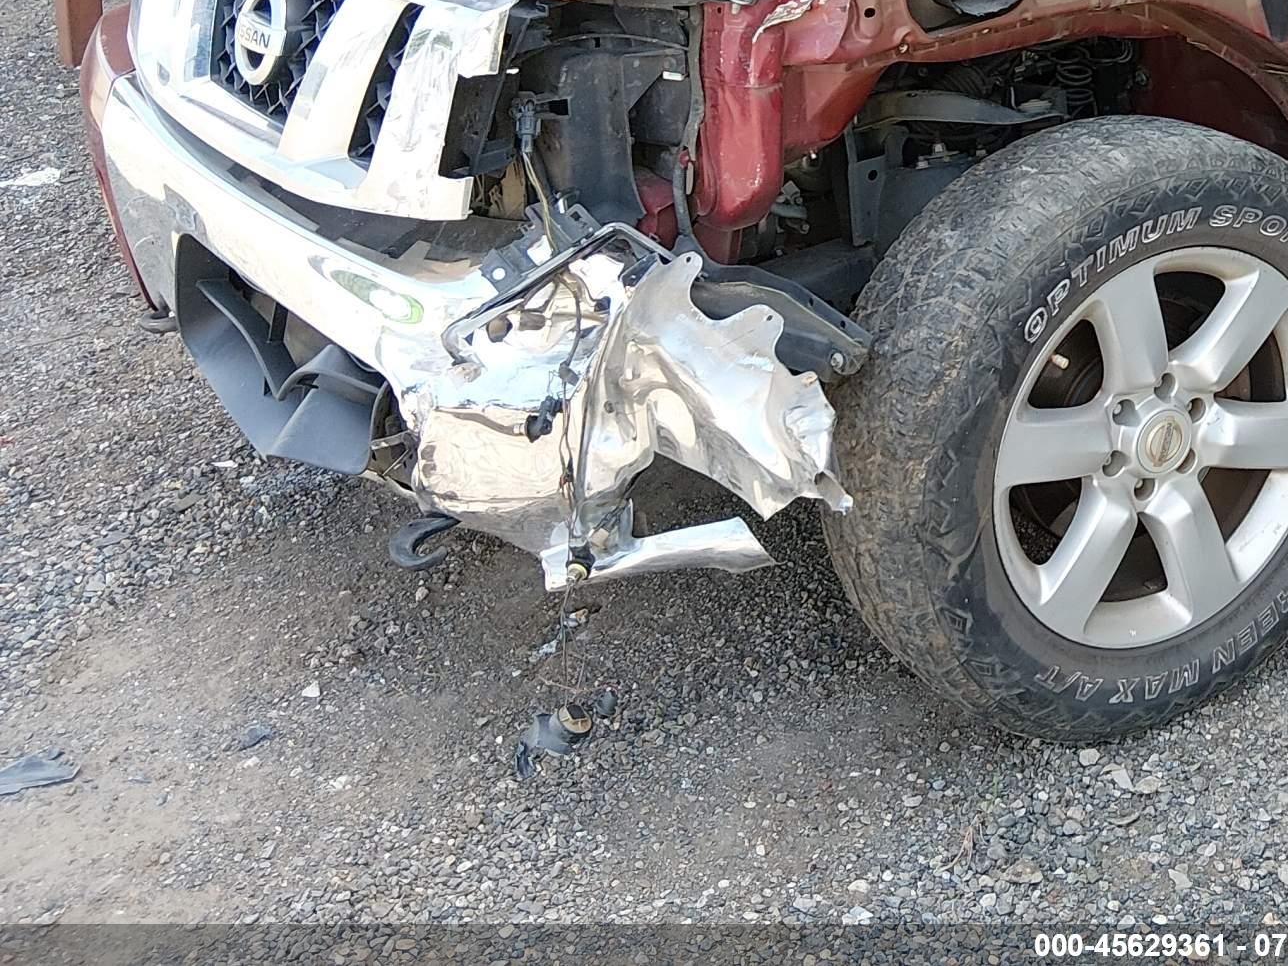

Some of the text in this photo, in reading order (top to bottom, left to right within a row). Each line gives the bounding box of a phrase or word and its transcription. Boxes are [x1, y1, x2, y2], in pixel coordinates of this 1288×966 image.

[1023, 206, 1203, 344] OPTIMUM
[1034, 664, 1104, 703] A/T
[1108, 658, 1200, 705] MAX
